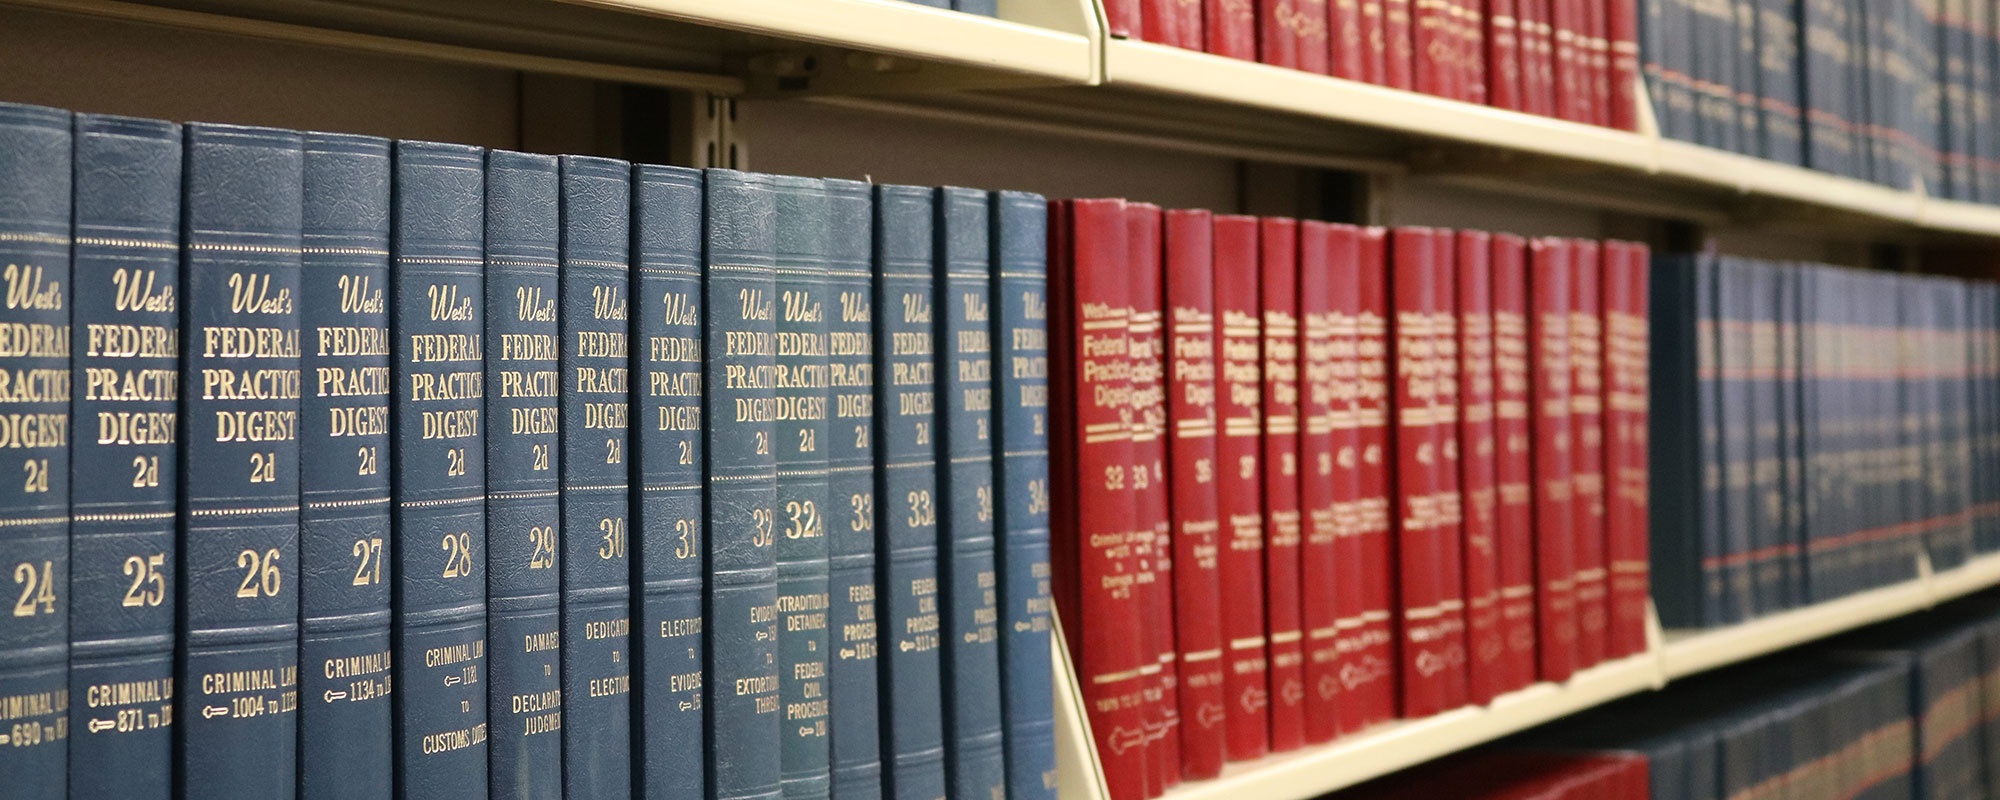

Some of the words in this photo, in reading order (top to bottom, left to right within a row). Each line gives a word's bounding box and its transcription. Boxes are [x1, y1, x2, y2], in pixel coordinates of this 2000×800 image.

[3, 264, 61, 311] West's
[113, 268, 174, 312] West's
[229, 273, 292, 314] West's
[338, 275, 384, 314] West's
[428, 284, 473, 321] West's
[516, 286, 556, 321] West's
[664, 293, 697, 326] West's
[783, 291, 822, 322] West's
[0, 323, 70, 357] EDERAL
[203, 327, 300, 358] FEDERAL
[317, 327, 390, 357] FEDERAL
[411, 334, 482, 362] FEDERAL
[577, 332, 628, 358] FEDERA
[726, 332, 776, 355] FEDERA
[86, 368, 177, 401] PRACTIC
[411, 372, 482, 400] PRACTICE
[501, 371, 558, 397] PRACTIC
[330, 407, 388, 436] DIGEST
[659, 407, 700, 431] DIGEST
[776, 397, 826, 419] DIGEST
[98, 412, 176, 445] DIGEST
[216, 411, 295, 442] DIGEST
[423, 409, 478, 439] DIGEST
[855, 426, 868, 448] 2d
[606, 439, 621, 464] 2d
[679, 441, 692, 464] 2d
[756, 432, 768, 454] 2d
[799, 429, 815, 452] 2d
[132, 455, 159, 488] 2d
[250, 453, 275, 483] 2d
[359, 447, 376, 475] 2d
[447, 449, 465, 476] 2d
[533, 445, 548, 470] 2d
[24, 459, 48, 493] 2d
[1105, 465, 1124, 489] 32
[786, 501, 823, 539] 32A
[851, 494, 872, 531] 33
[600, 518, 624, 560] 30
[675, 519, 697, 559] 31
[753, 509, 773, 547] 32
[442, 532, 471, 578] 28
[529, 526, 555, 568] 29
[236, 548, 281, 598] 26
[352, 538, 382, 586] 27
[14, 561, 56, 616] 24
[122, 553, 165, 607] 25
[324, 653, 382, 679] CRIMINAL
[426, 644, 471, 668] CRIMINAL
[612, 650, 620, 662] TO
[688, 647, 695, 659] TO
[203, 669, 276, 695] CRIMINAL
[462, 665, 478, 685] 1181
[544, 664, 552, 676] TO
[794, 662, 825, 680] FEDERAL
[87, 680, 161, 708] CRIMINAL
[350, 679, 374, 702] 1134
[376, 684, 384, 697] TO
[232, 696, 264, 718] 1004
[268, 700, 278, 714] TO
[461, 700, 470, 713] TO
[12, 722, 41, 747] 690
[117, 709, 144, 733] 871
[423, 729, 469, 755] CUSTOMS
